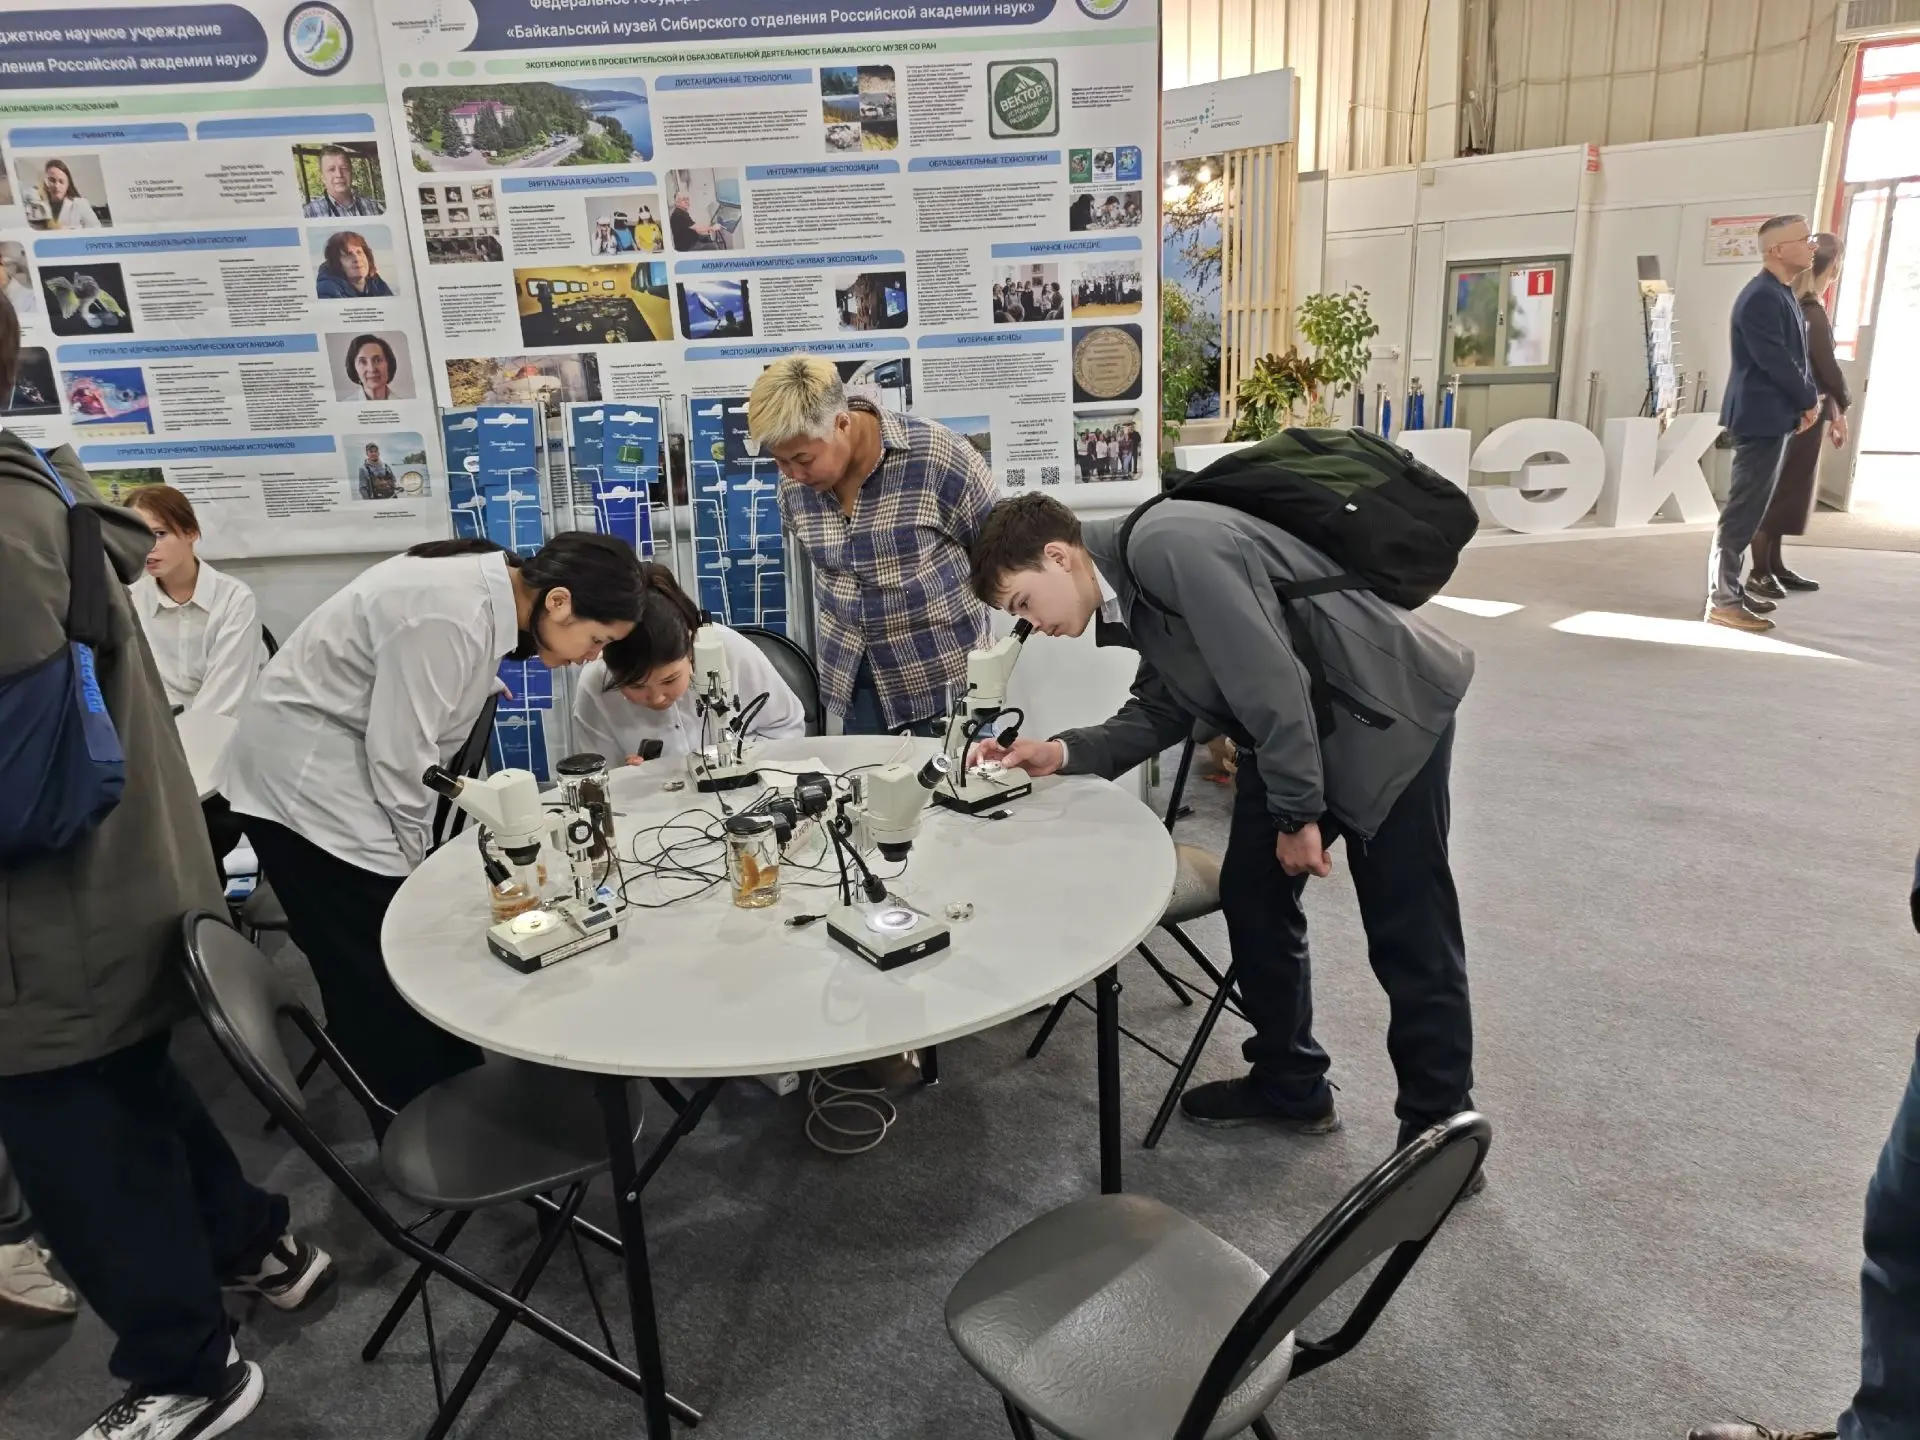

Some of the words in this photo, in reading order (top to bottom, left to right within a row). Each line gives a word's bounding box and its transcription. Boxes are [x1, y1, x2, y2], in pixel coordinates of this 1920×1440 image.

[507, 20, 610, 39] «Байкальский
[613, 18, 658, 36] музей
[661, 16, 748, 32] Сибирского
[751, 12, 827, 28] отделения
[831, 6, 916, 23] Российской
[919, 4, 991, 19] академии
[995, 2, 1035, 17] наук»
[65, 27, 126, 44] научное
[130, 23, 222, 42] учреждение
[0, 61, 46, 73] ления
[48, 56, 138, 73] Российской
[140, 54, 213, 71] академии
[216, 51, 257, 68] наук»
[525, 59, 591, 69] ЭКОТЕХНОЛОГИИ
[592, 58, 598, 66] В
[598, 54, 678, 66] ПРОСВЕТИТЕЛЬСКОЙ
[679, 54, 685, 62] И
[686, 51, 760, 62] ОБРАЗОВАТЕЛЬНОЙ
[761, 48, 820, 59] ДЕЯТЕЛЬНОСТИ
[822, 45, 882, 55] БАЙКАЛЬСКОГО
[883, 43, 908, 52] МУЗЕЯ
[909, 43, 920, 51] СО
[921, 42, 937, 50] РАН
[675, 76, 742, 87] ДИСТАНЦИОННЫЕ
[744, 74, 792, 84] ТЕХНОЛОГИИ
[1000, 84, 1043, 112] ВЕКТОР
[928, 157, 998, 168] ОБРАЗОВАТЕЛЬНЫЕ
[1000, 154, 1048, 164] ТЕХНОЛОГИИ
[767, 166, 828, 176] ИНТЕРАКТИВНЫЕ
[830, 163, 879, 174] ЭКСПОЗИЦИИ
[528, 179, 581, 188] ВИРТУАЛЬНАЯ
[582, 176, 630, 186] РЕАЛЬНОСТЬ
[1030, 243, 1061, 252] НАУЧНОЕ
[1063, 241, 1101, 250] НАСЛЕДИЕ
[701, 259, 755, 270] АКВАРИУМНЫЙ
[757, 258, 795, 267] КОМПЛЕКС
[796, 256, 825, 265] «ЖИВАЯ
[827, 254, 878, 264] ЭКСПОЗИЦИЯ»
[957, 335, 995, 344] МУЗЕЙНЫЕ
[996, 334, 1022, 342] ФОНДЫ
[720, 346, 767, 356] ЭКСПОЗИЦИЯ
[809, 343, 834, 351] ЖИЗНИ
